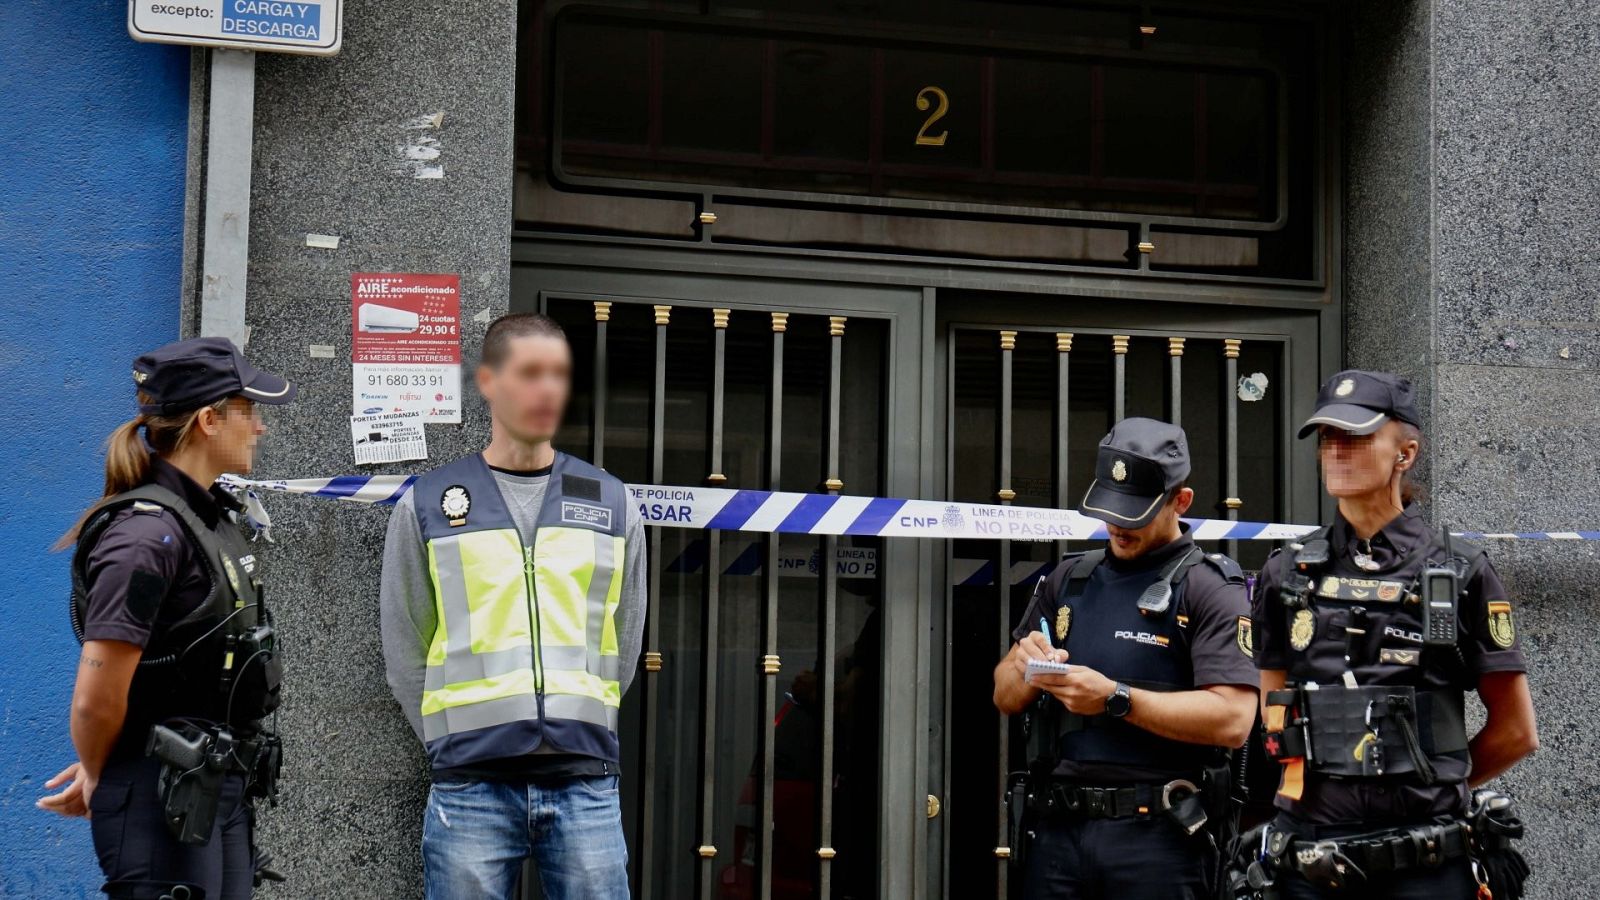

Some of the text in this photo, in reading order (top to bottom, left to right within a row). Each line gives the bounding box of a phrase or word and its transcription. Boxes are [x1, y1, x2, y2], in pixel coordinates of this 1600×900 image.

[151, 4, 214, 19] excepto:
[234, 0, 309, 18] CARGA Y
[223, 18, 317, 38] DESCARGA
[916, 86, 949, 145] 2
[357, 283, 456, 294] AIRE acondicionado
[420, 325, 447, 335] 29,90
[368, 375, 443, 386] 91 680 33 91
[383, 411, 420, 420] MUDANZAS
[647, 489, 694, 501] POLICIA
[565, 505, 608, 518] POLICIA
[574, 513, 599, 521] CNP
[639, 503, 692, 522] ASAR
[972, 507, 1070, 521] LINEA DE POLICIA
[900, 516, 938, 528] CNP
[975, 520, 1073, 537] NO PASAR
[1114, 630, 1157, 642] POLICIA
[1384, 626, 1424, 643] POLICI
